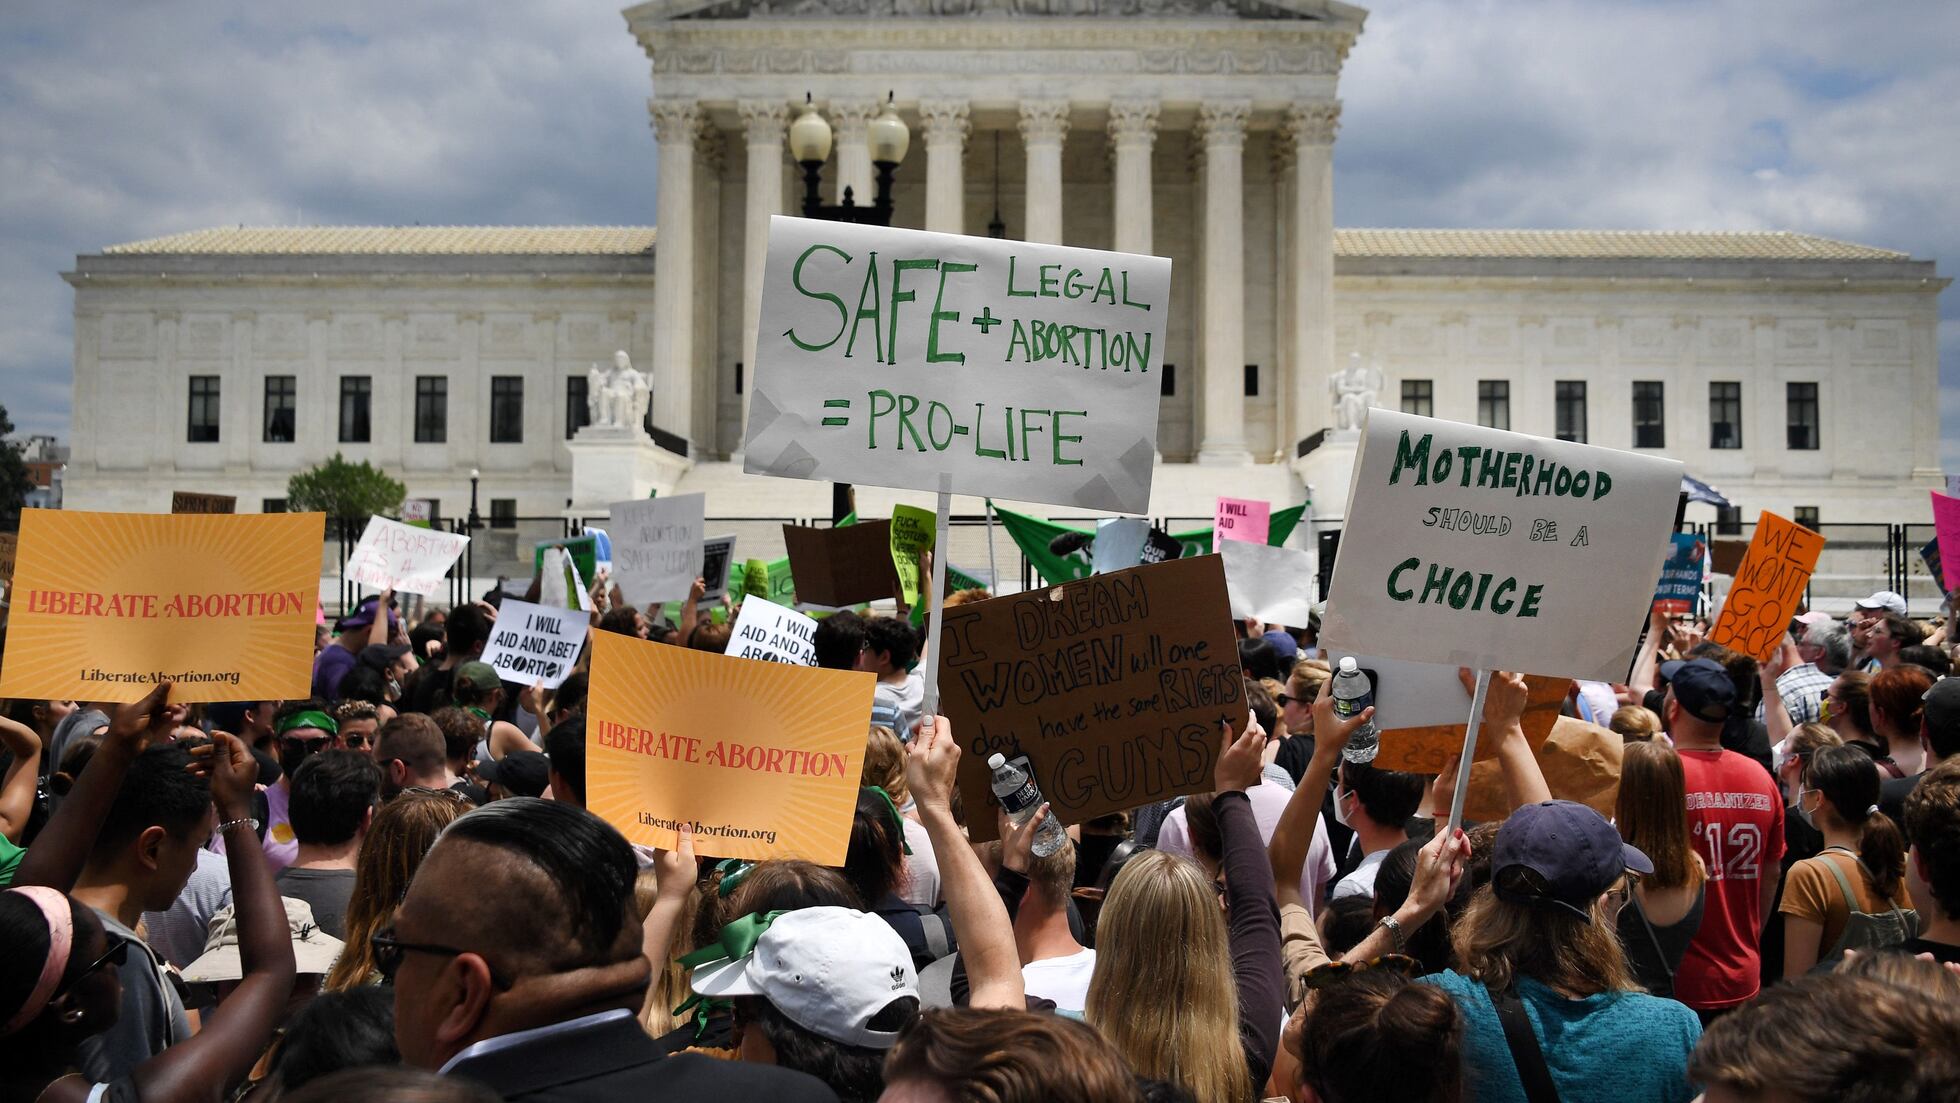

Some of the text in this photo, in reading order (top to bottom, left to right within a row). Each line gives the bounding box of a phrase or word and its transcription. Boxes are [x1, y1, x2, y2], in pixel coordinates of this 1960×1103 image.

[783, 244, 978, 365] SAFE
[1008, 256, 1151, 311] LEGAL
[1005, 320, 1152, 372] ABORTION
[868, 390, 1088, 465] PRO-LIFE
[1389, 429, 1612, 500] MOTHERHOOD
[896, 516, 919, 529] FUCK
[1218, 518, 1234, 529] AID
[1226, 503, 1247, 516] WILL
[1422, 507, 1589, 547] SHOULD BE A
[1765, 513, 1812, 565] WE
[1387, 557, 1544, 617] CHOICE
[1743, 548, 1811, 604] WONT
[28, 590, 304, 618] LIBERATE ABORTION
[526, 614, 561, 635] I WILL
[775, 615, 782, 628] I
[942, 575, 1149, 667] I DREAM
[1731, 587, 1782, 628] GO
[494, 631, 577, 659] AID AND ABET
[740, 624, 767, 642] AID
[768, 634, 800, 655] AND
[1712, 610, 1783, 662] BACK
[492, 652, 565, 678] ABORTION
[961, 635, 1210, 713] WOMEN will one
[599, 720, 848, 778] LIBERATE ABORTION
[972, 723, 1020, 757] day
[1038, 715, 1089, 741] have
[1091, 702, 1121, 723] the
[1052, 723, 1210, 810] GUNS
[1686, 792, 1772, 811] ORGANIZER
